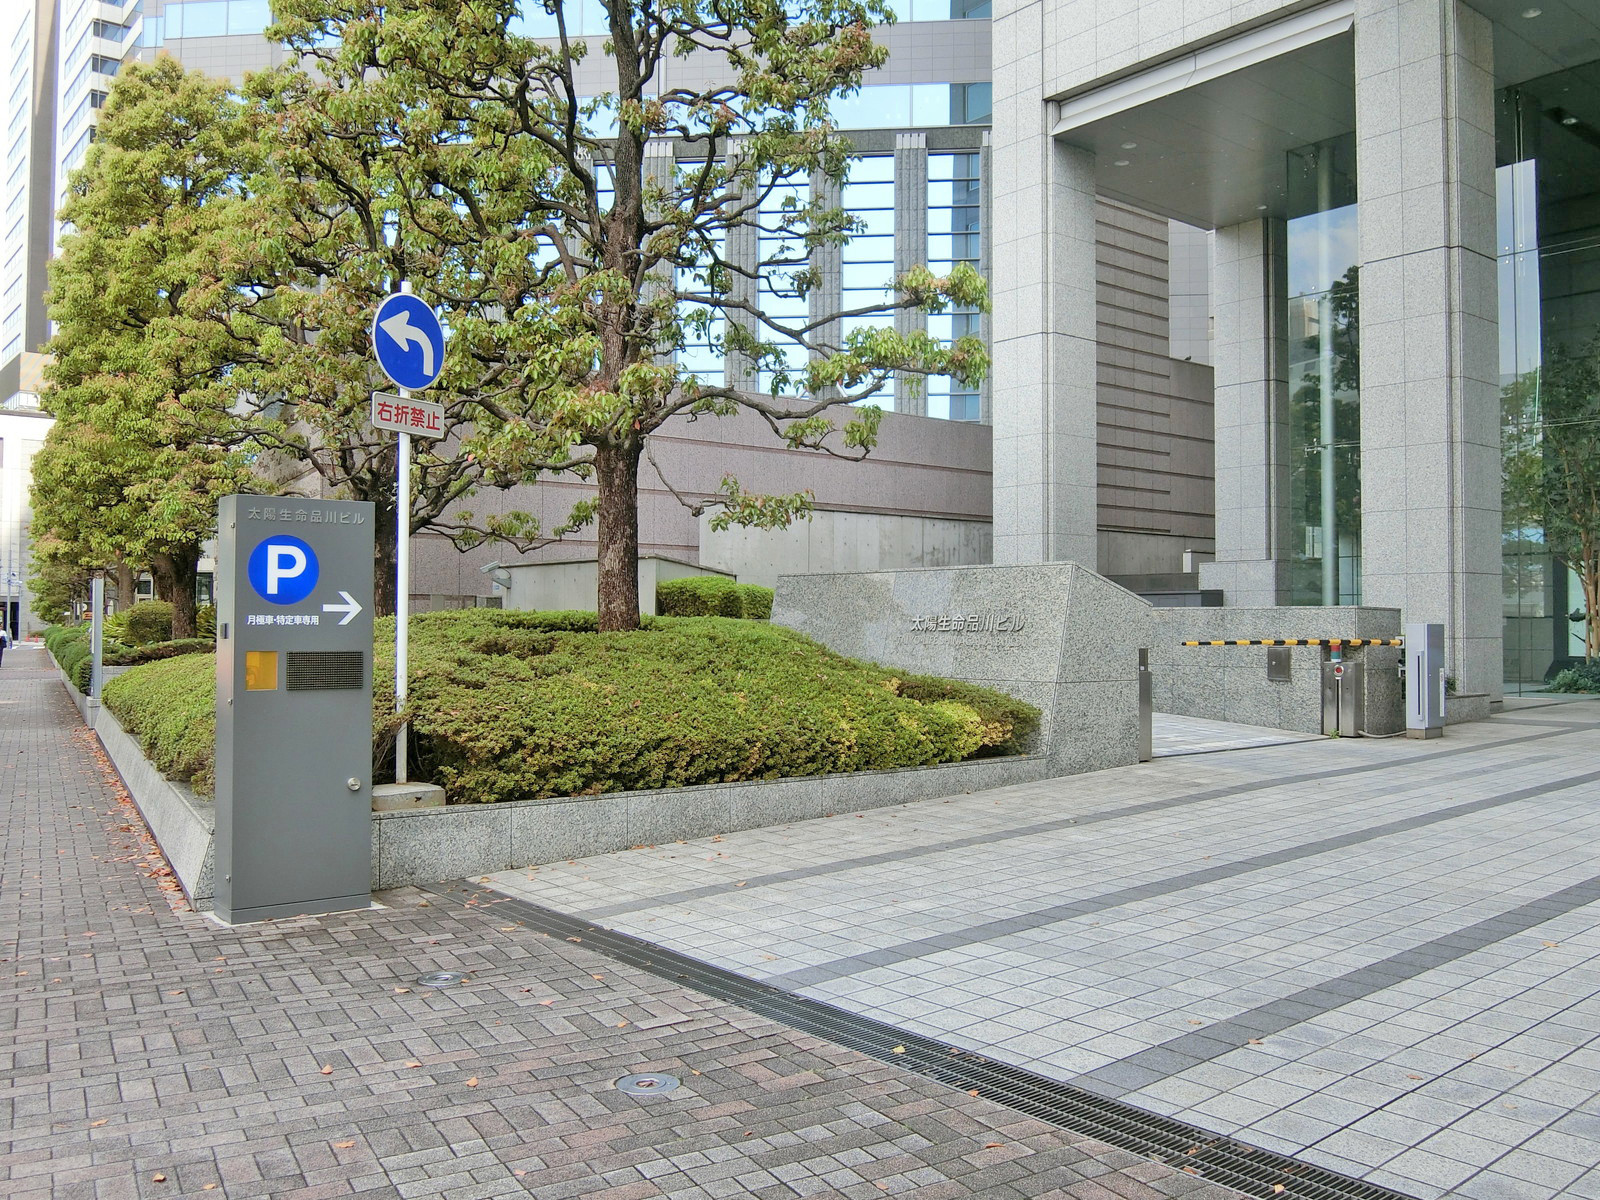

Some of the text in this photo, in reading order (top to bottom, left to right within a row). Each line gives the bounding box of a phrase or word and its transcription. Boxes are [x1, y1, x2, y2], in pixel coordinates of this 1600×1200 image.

[377, 401, 441, 431] 右折禁止
[248, 507, 365, 525] 太陽生命品川ビル
[267, 544, 307, 595] P
[911, 614, 1026, 632] 太陽生命品川ビル
